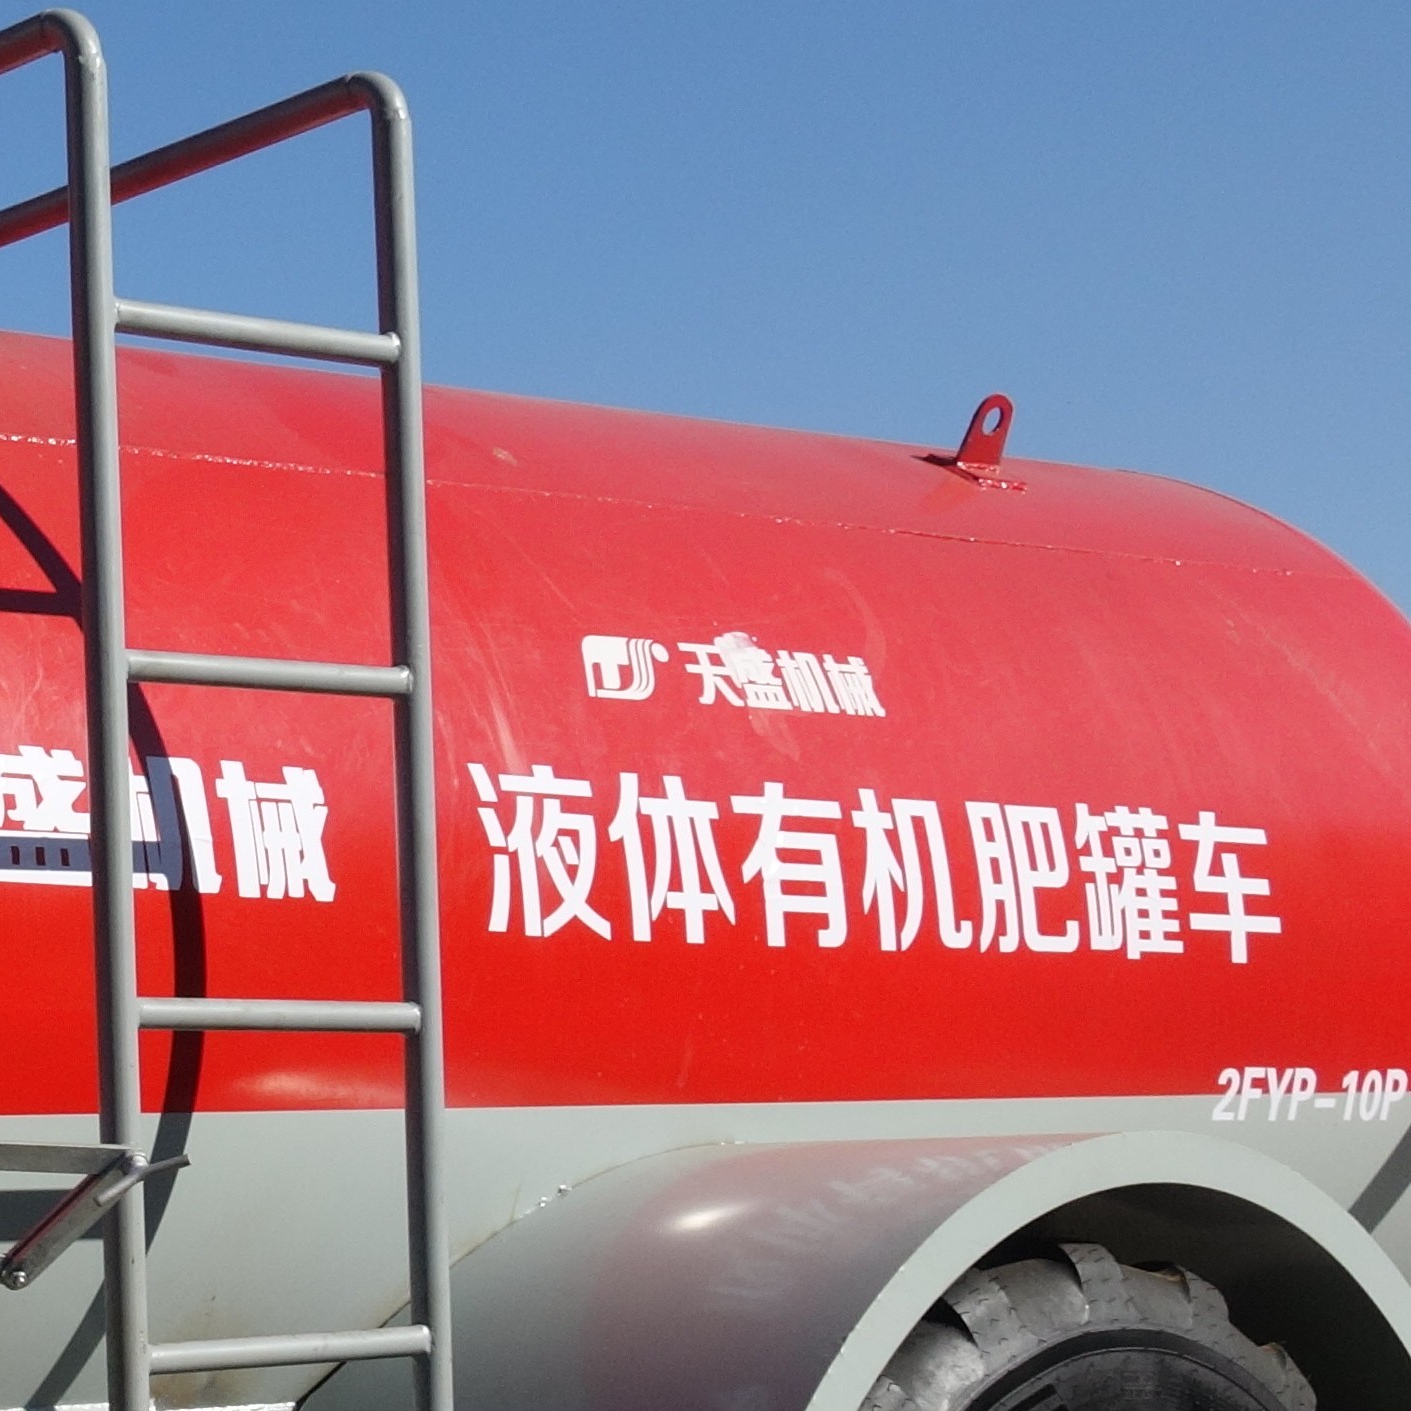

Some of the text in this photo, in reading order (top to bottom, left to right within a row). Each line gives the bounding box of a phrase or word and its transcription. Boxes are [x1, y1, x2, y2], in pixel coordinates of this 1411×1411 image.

[677, 638, 886, 718] 天盛机械
[466, 762, 1282, 965] 液体有机肥罐车
[1211, 1066, 1409, 1122] 2FYP-10P
